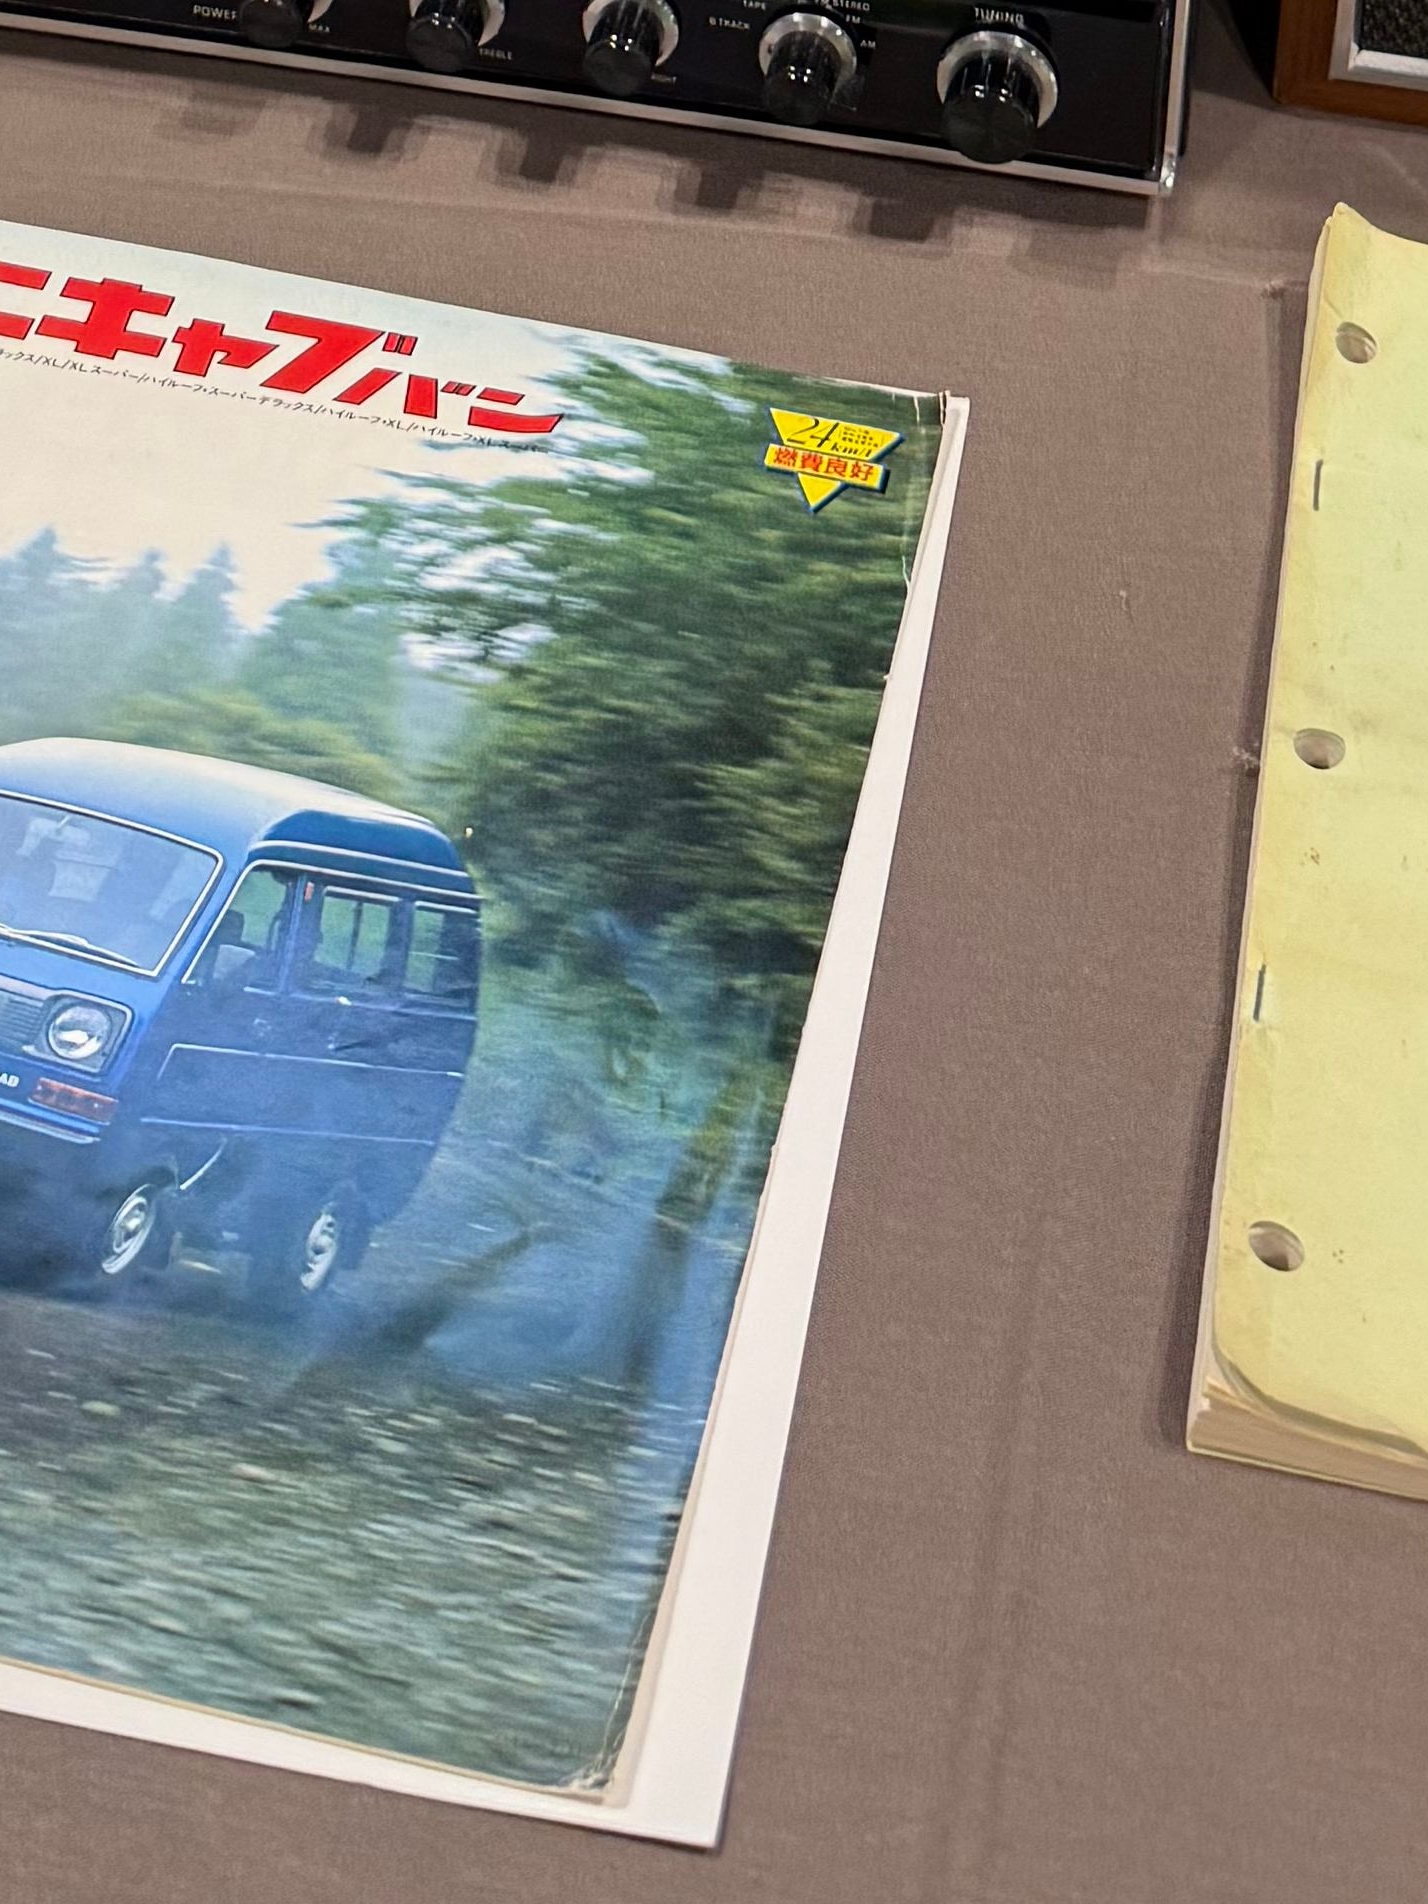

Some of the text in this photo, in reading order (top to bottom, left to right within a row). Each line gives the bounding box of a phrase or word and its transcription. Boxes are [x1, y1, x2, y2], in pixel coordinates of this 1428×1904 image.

[786, 418, 840, 448] 24
[773, 446, 874, 482] 燃費良好
